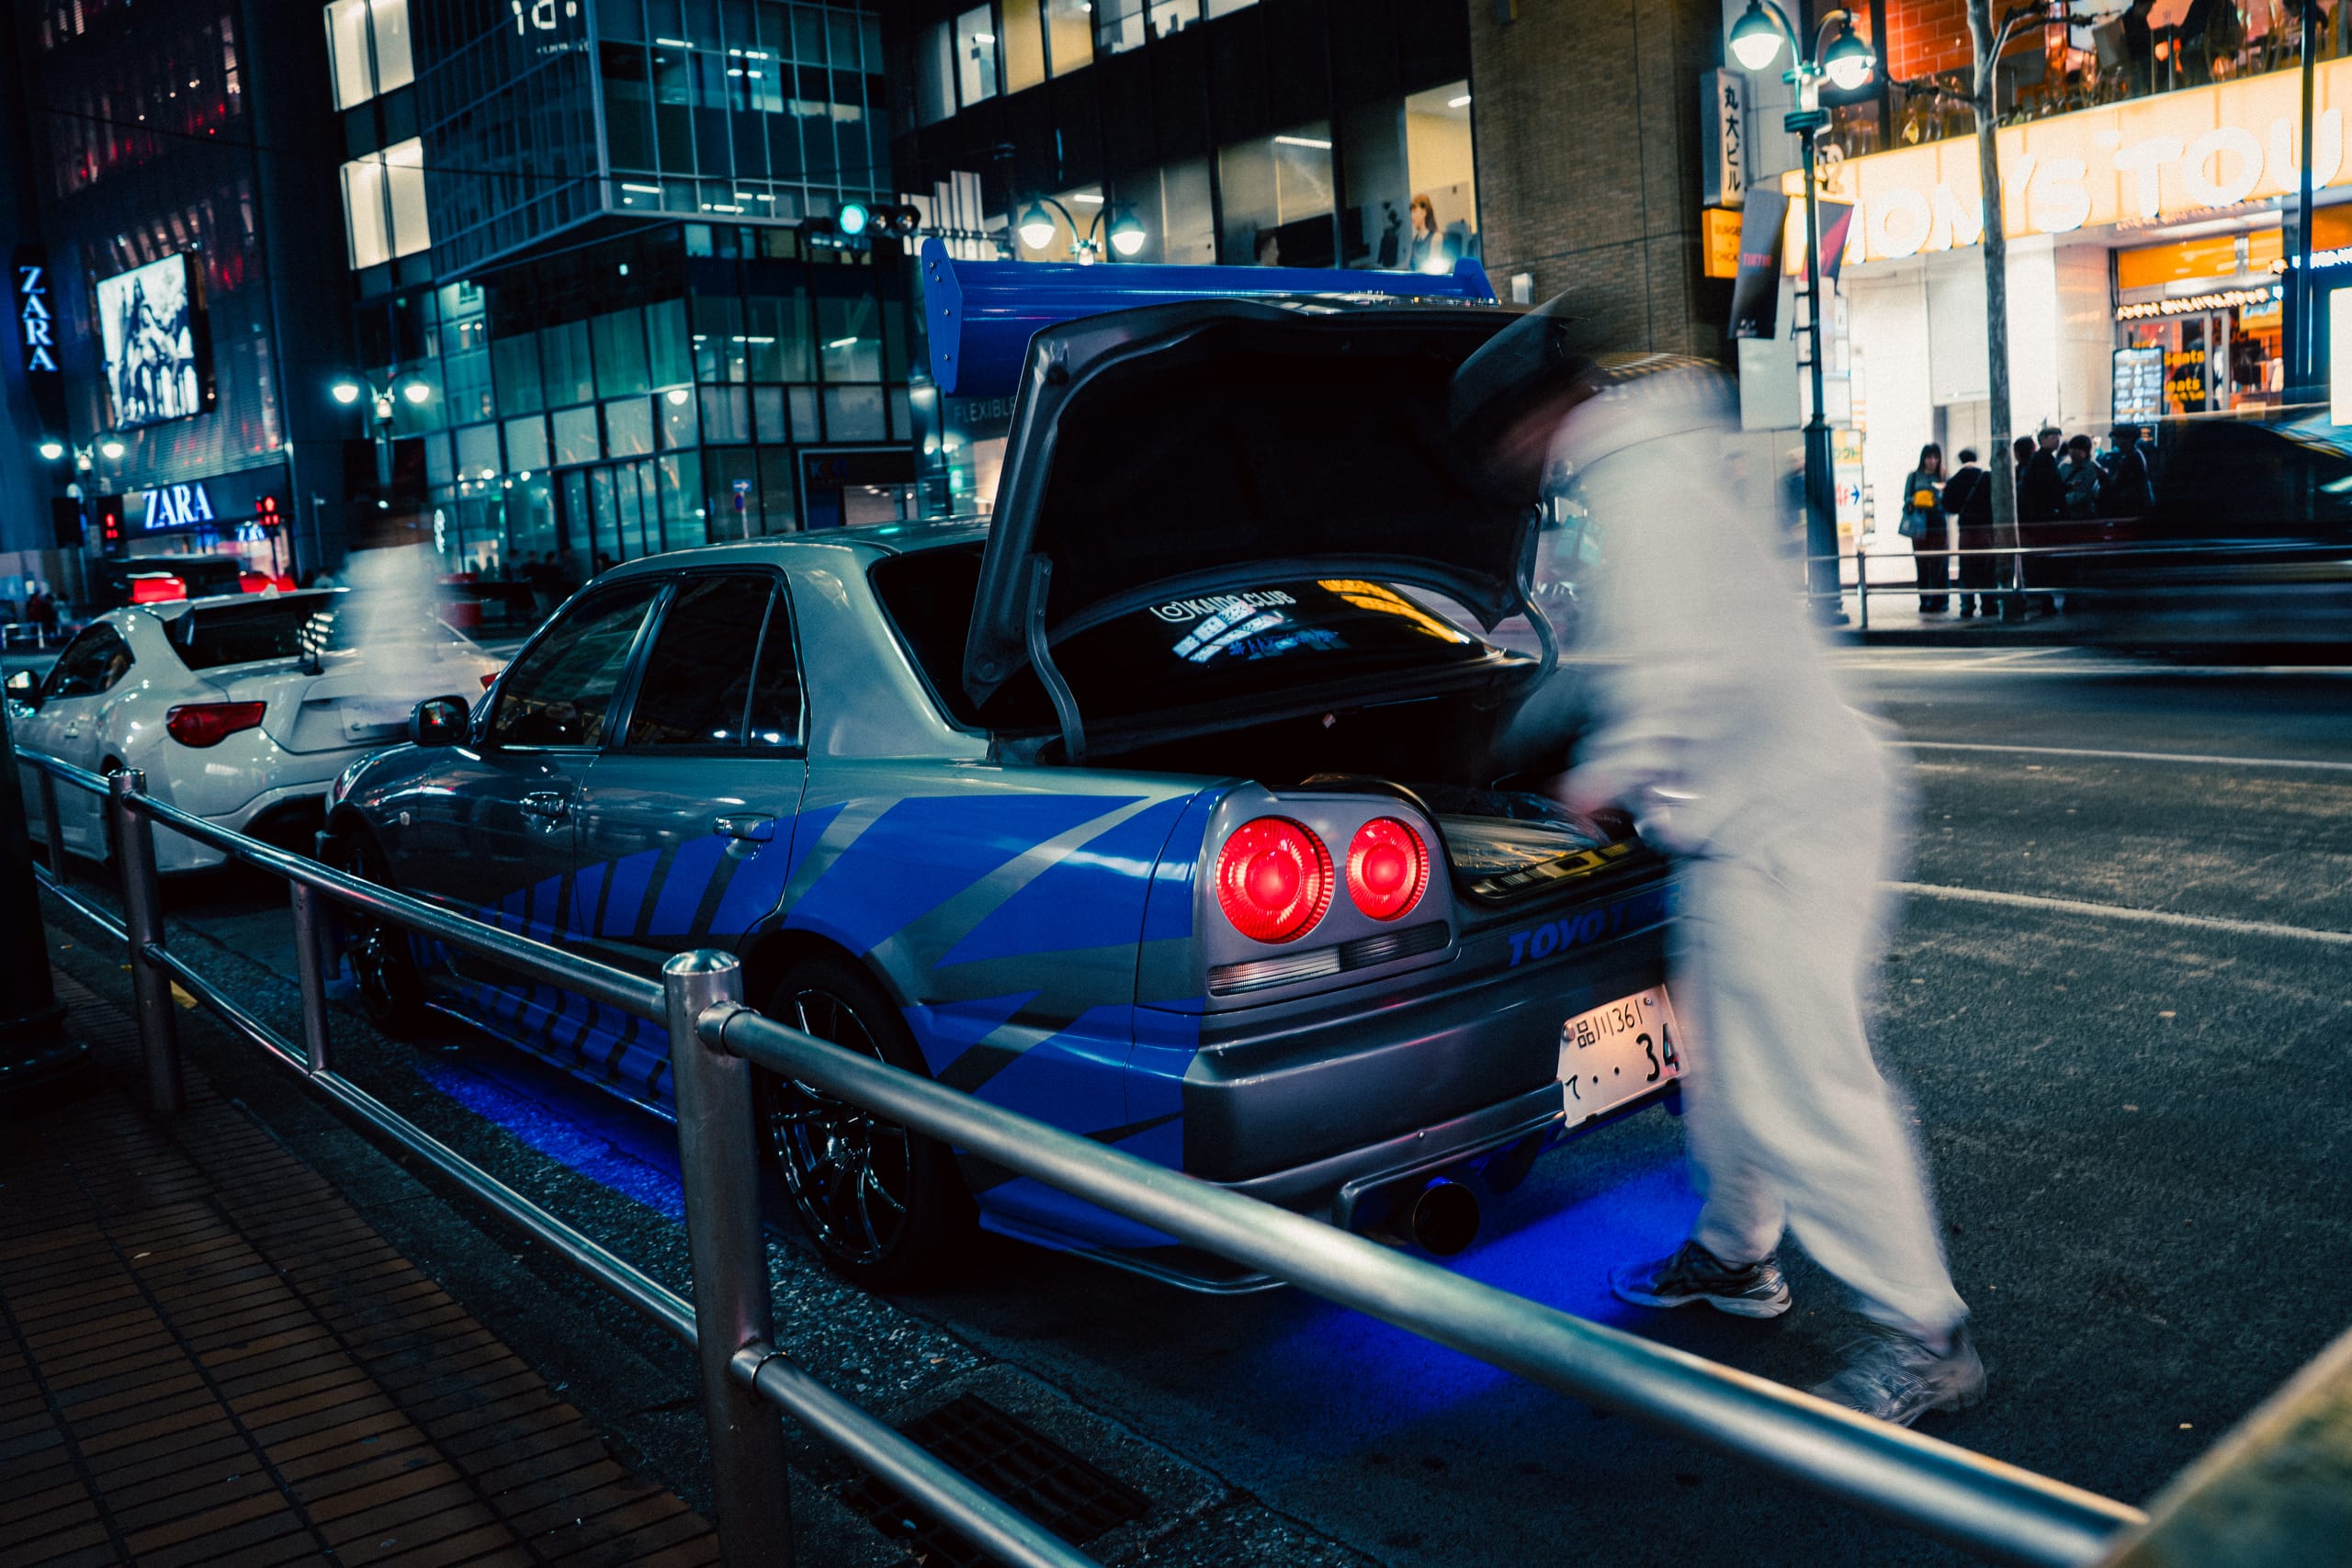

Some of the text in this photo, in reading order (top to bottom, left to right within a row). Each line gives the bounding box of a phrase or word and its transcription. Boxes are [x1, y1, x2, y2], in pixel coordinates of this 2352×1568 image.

[1724, 85, 1741, 193] 丸大ビル
[2115, 108, 2352, 218] TOU
[18, 265, 59, 372] ZARA
[141, 481, 214, 529] ZARA
[1577, 998, 1644, 1049] 品川 361
